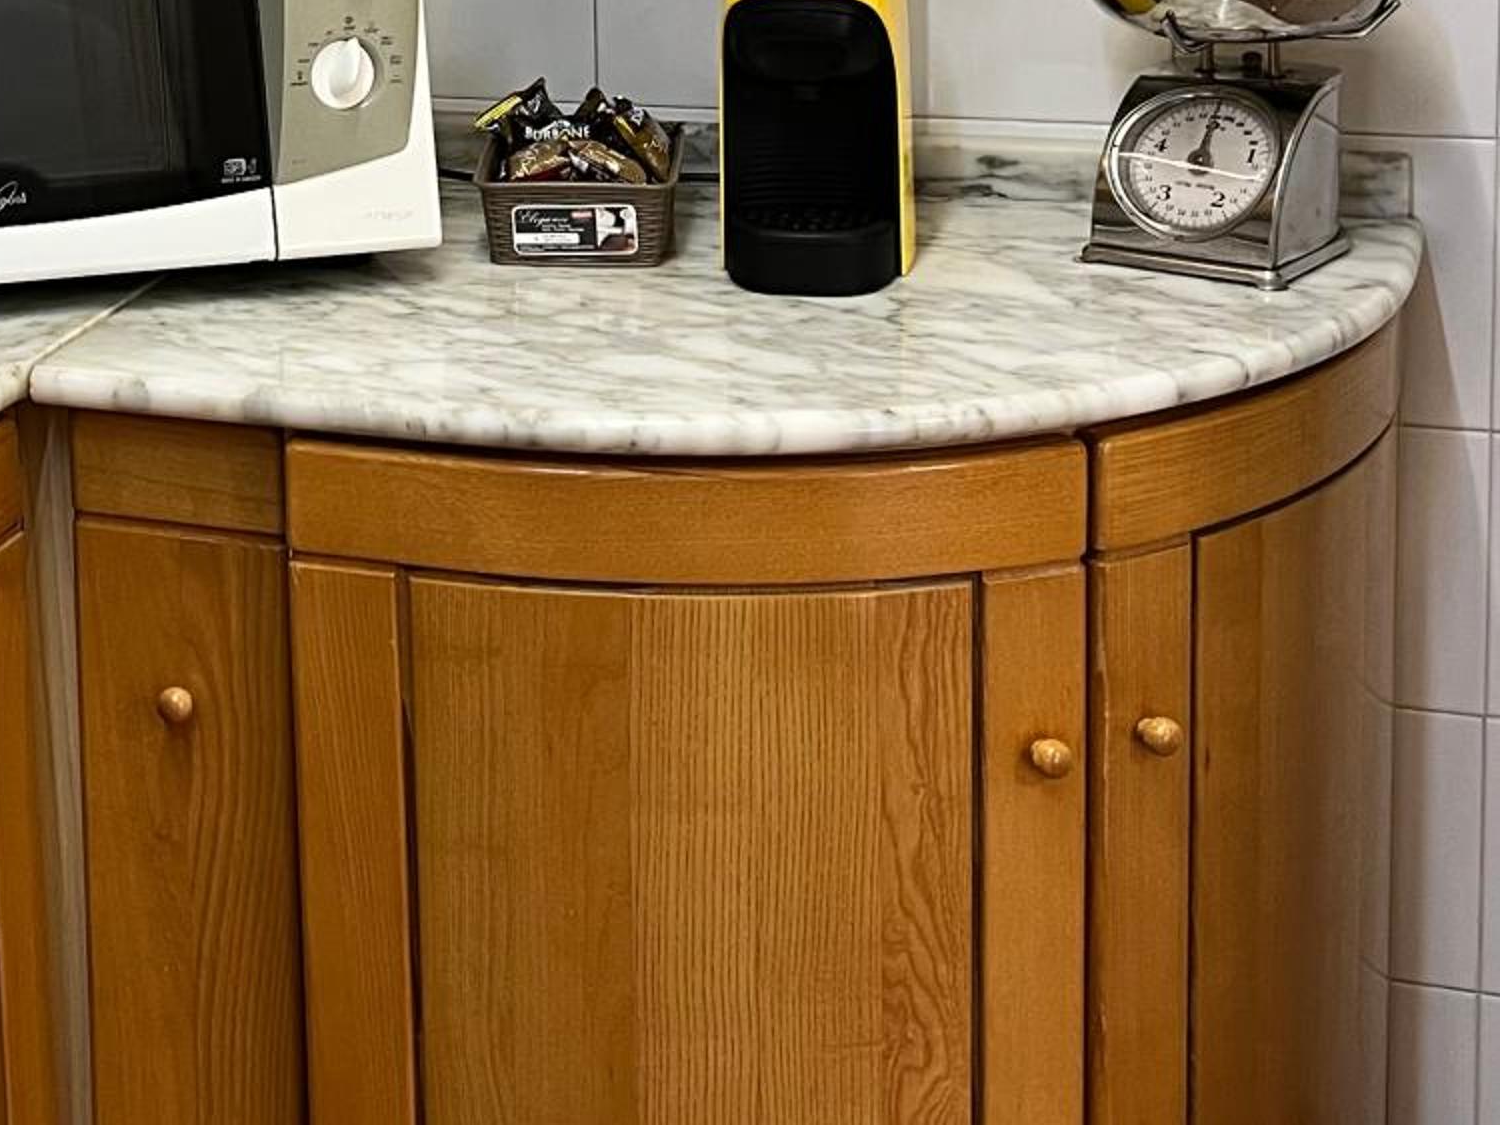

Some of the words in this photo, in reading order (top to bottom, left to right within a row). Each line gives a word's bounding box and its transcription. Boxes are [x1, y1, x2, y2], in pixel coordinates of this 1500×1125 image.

[1153, 138, 1169, 153] 4
[1156, 184, 1172, 201] 3
[1210, 191, 1226, 208] 2
